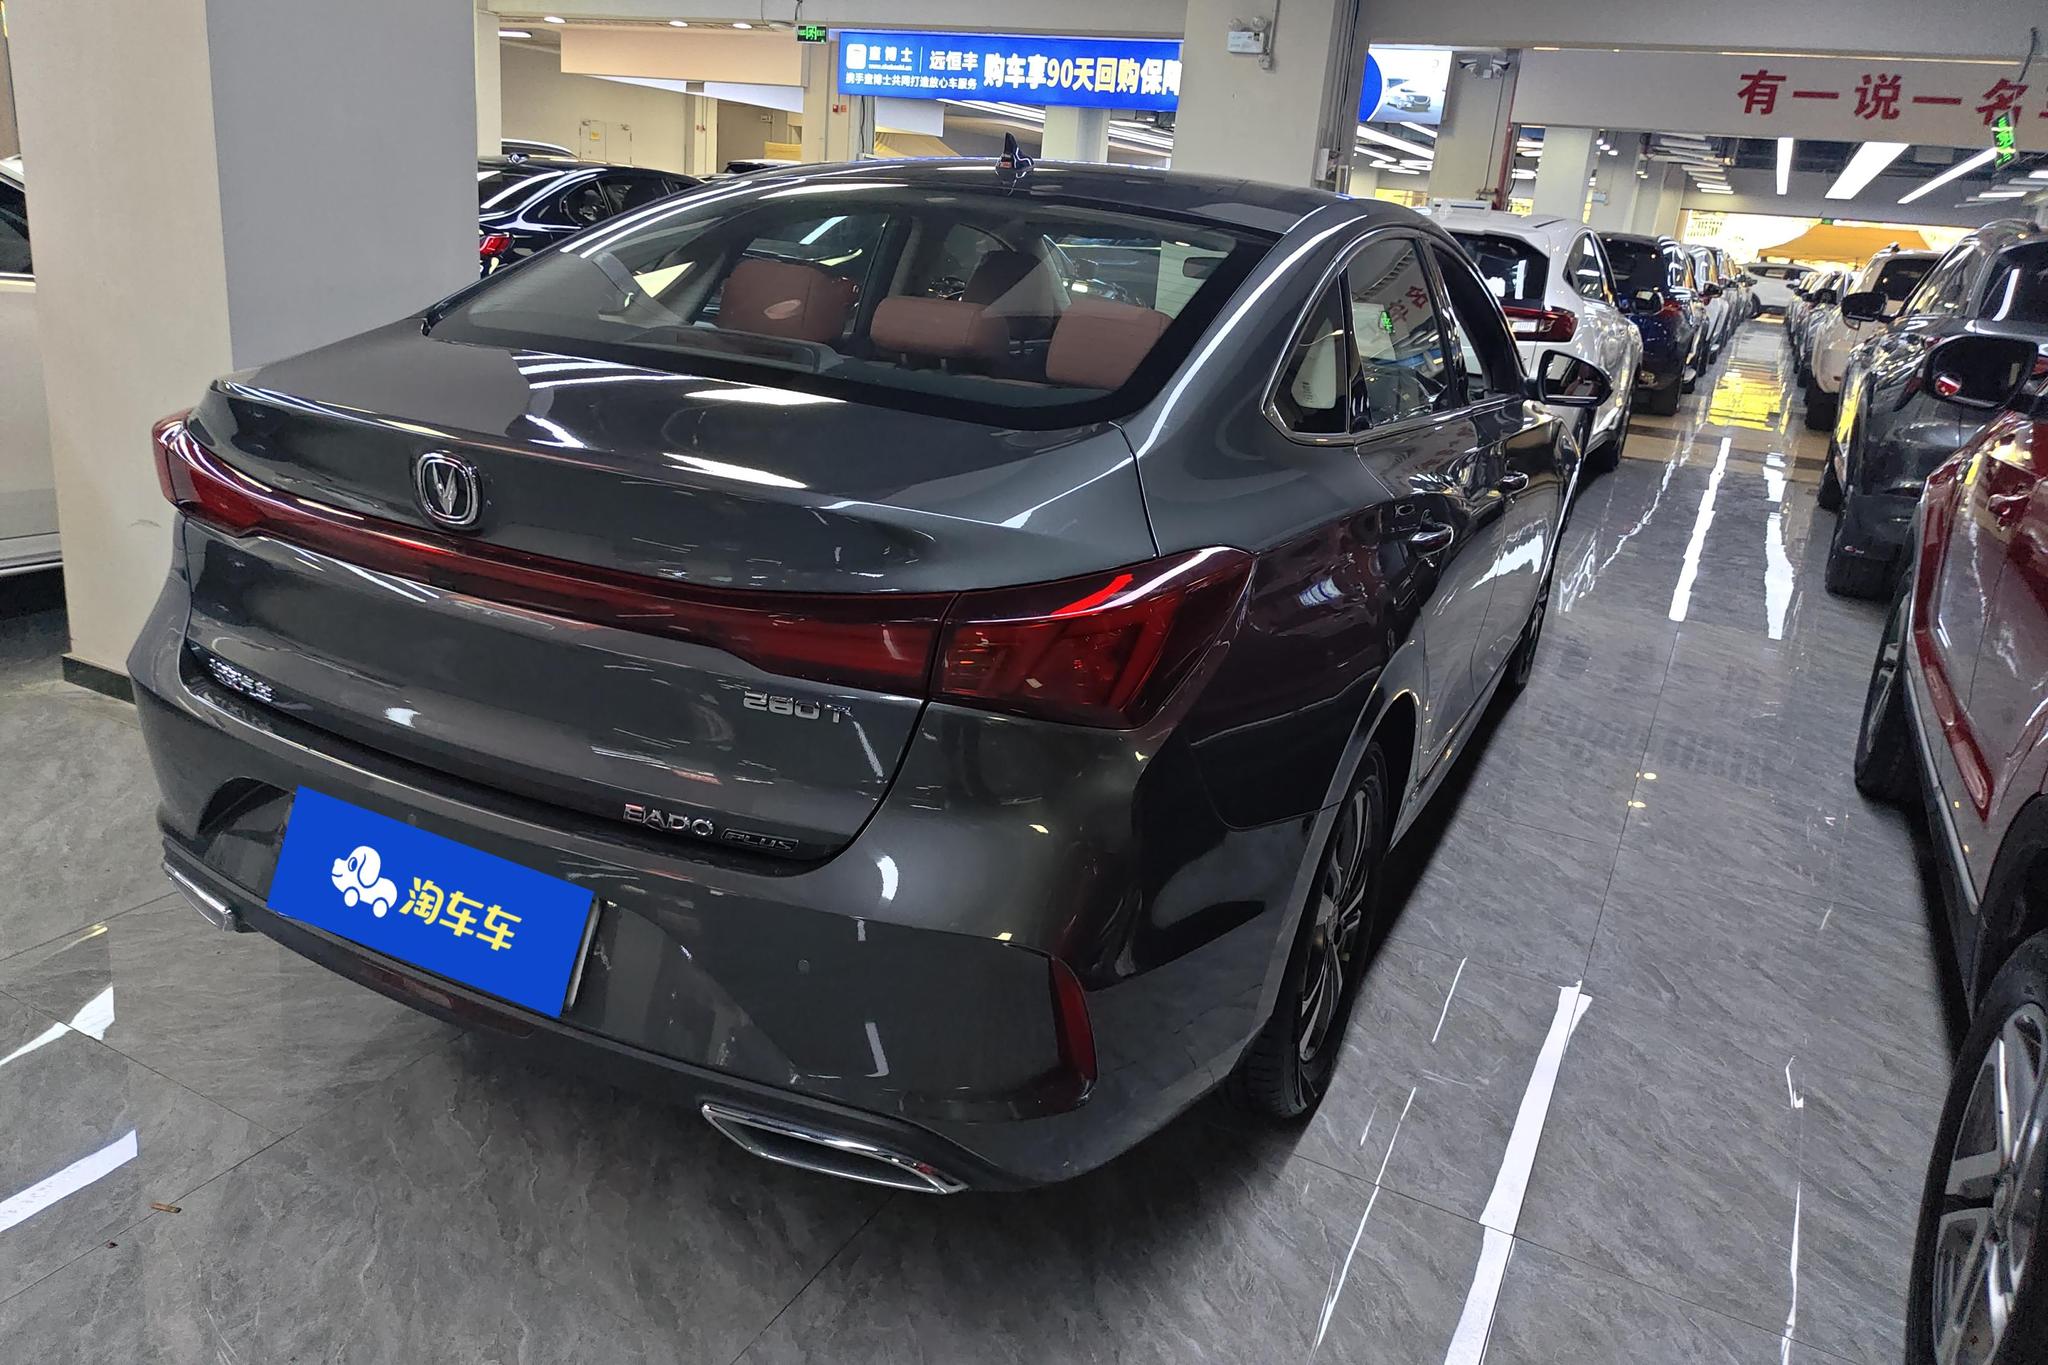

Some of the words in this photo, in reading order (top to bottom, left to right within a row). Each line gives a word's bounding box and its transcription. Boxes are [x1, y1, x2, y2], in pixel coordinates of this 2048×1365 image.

[929, 50, 979, 72] 远恒丰
[1738, 69, 2048, 127] 有一说一名
[623, 803, 714, 836] EADO
[725, 831, 794, 851] PLUS
